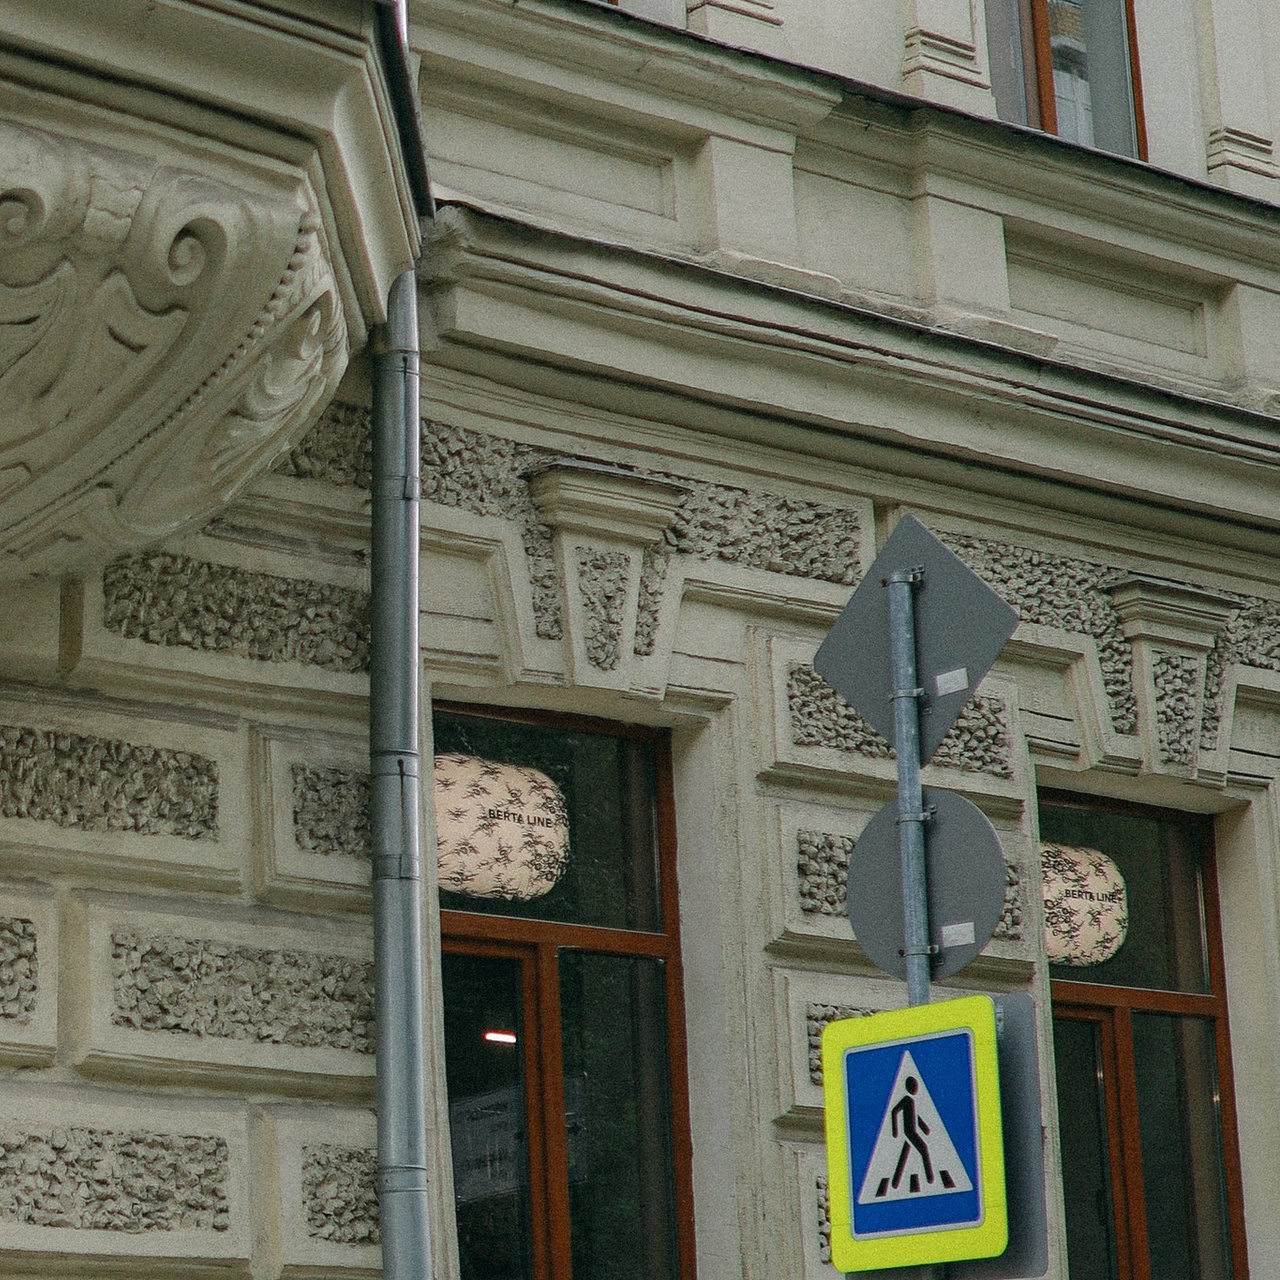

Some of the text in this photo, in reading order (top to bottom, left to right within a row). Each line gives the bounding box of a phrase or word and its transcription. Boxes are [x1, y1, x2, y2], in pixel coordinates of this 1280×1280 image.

[488, 808, 553, 828] BERTA LINE
[1064, 888, 1118, 904] BERTA LINE
